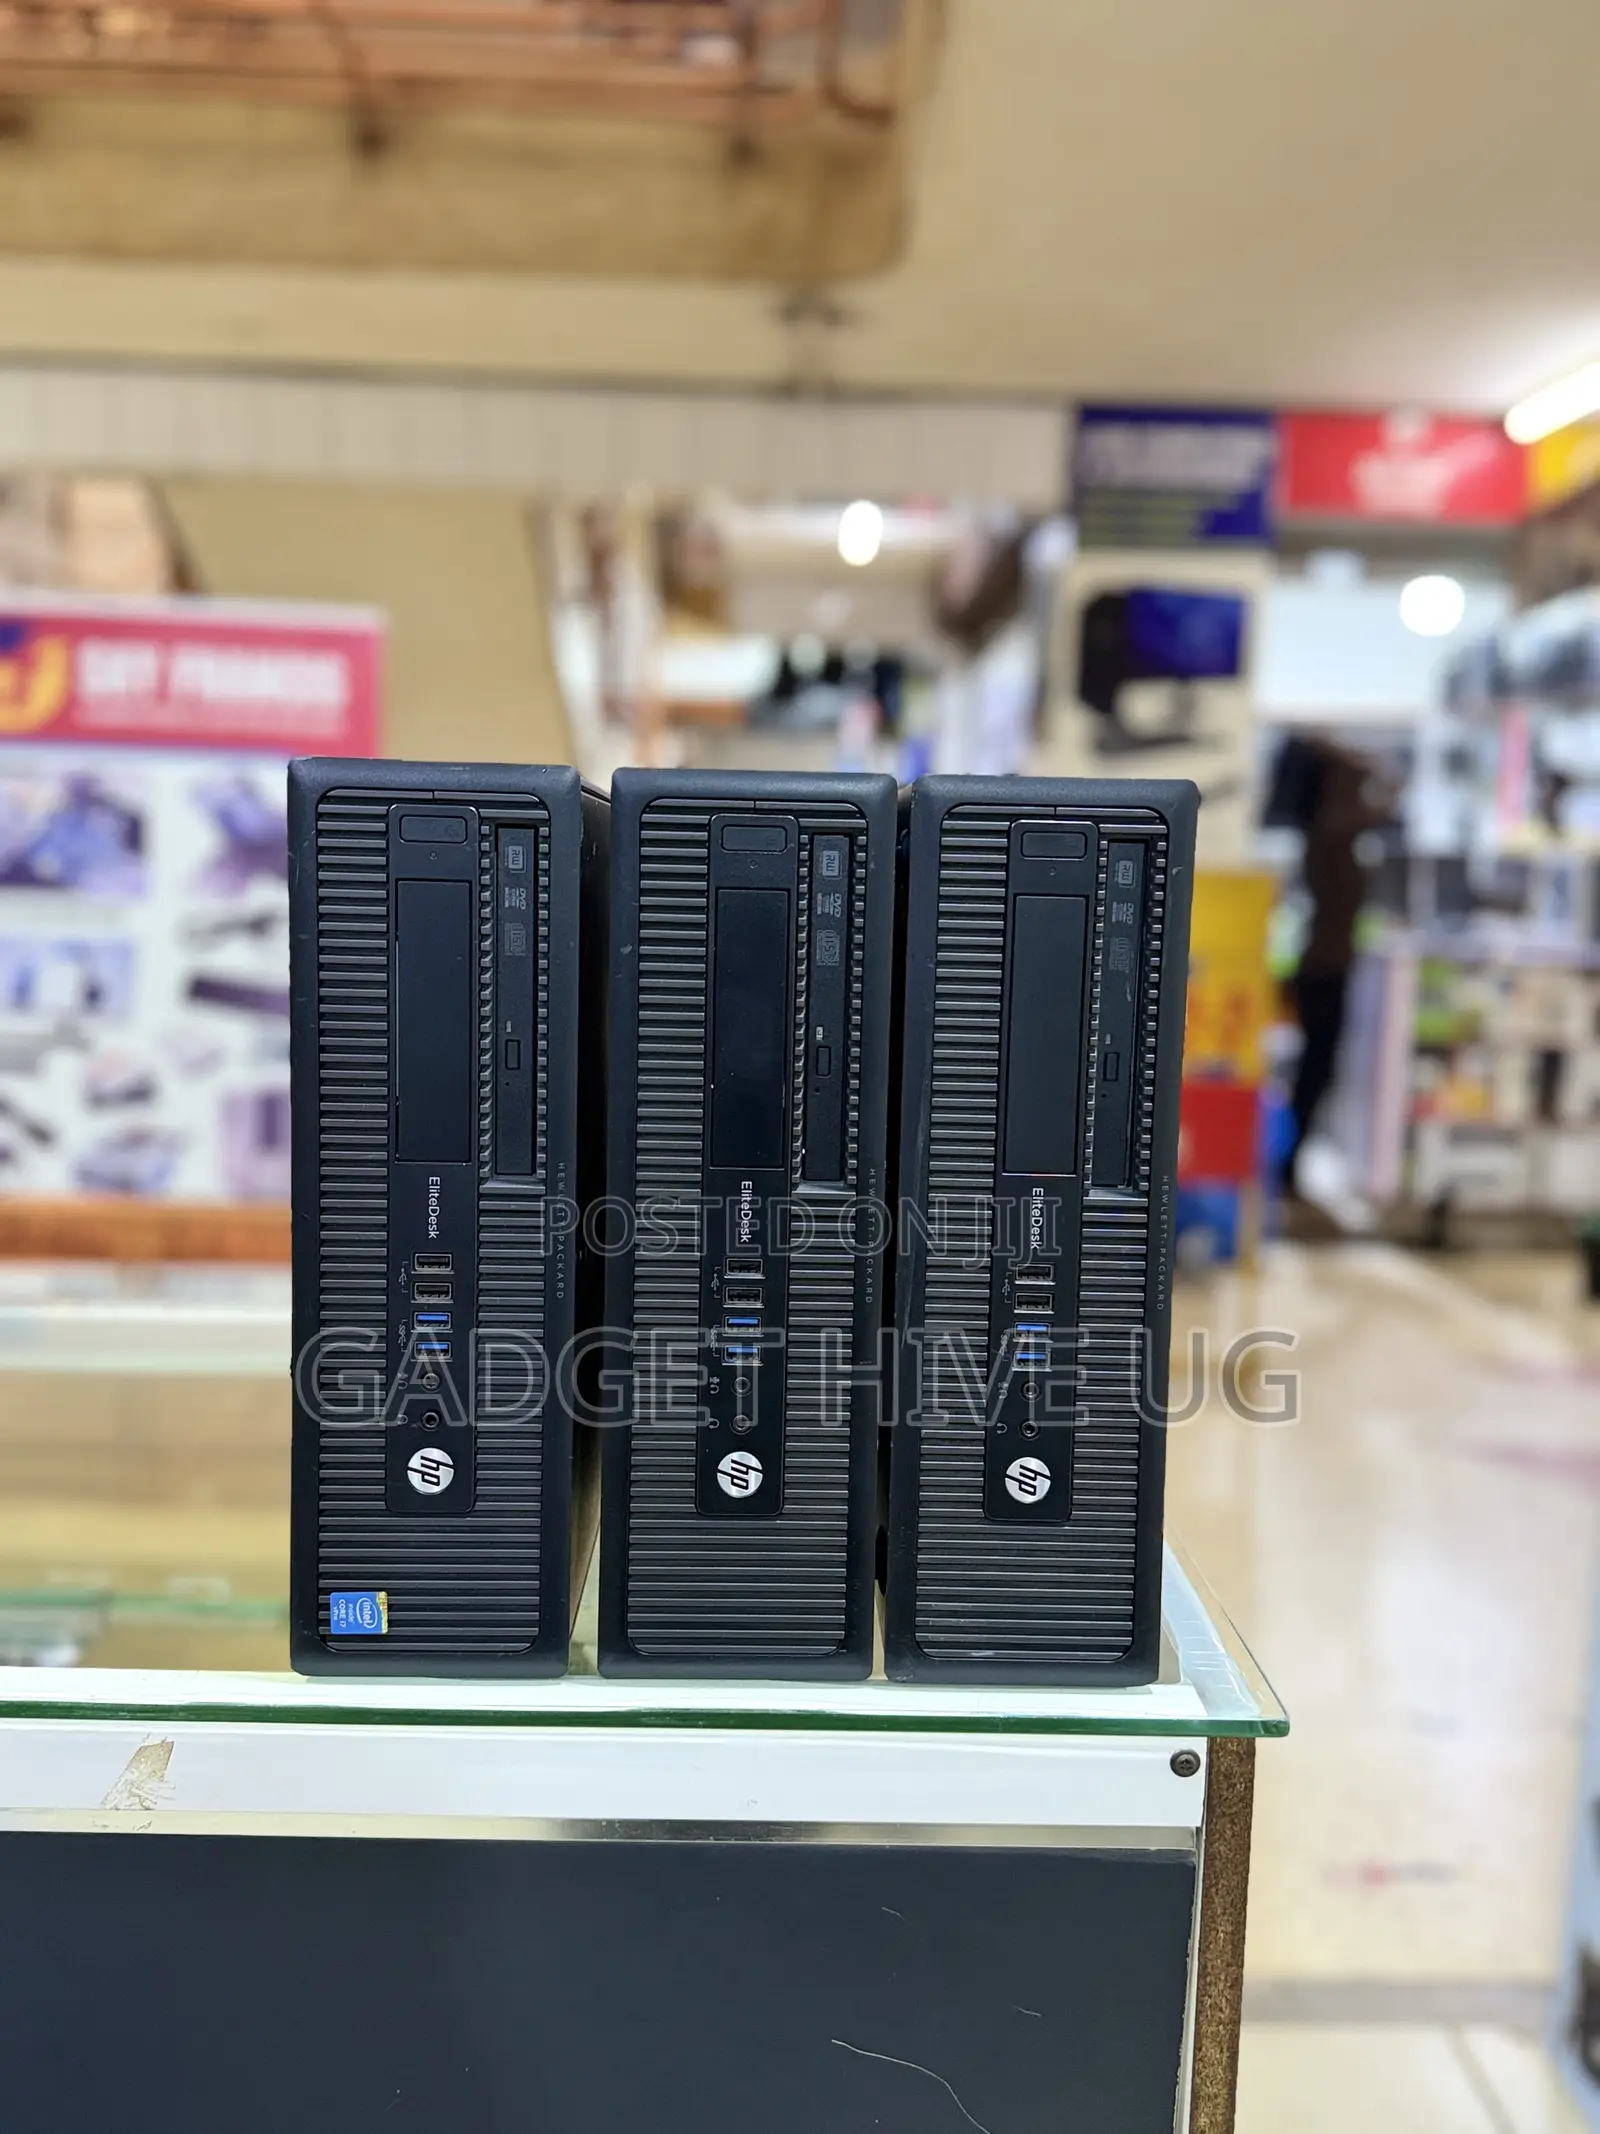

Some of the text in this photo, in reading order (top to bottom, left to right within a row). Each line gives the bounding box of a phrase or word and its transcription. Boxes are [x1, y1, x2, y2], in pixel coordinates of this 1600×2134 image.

[826, 854, 836, 872] RW
[519, 887, 527, 910] DVD
[833, 893, 842, 918] DVD
[1126, 902, 1134, 924] DVD
[428, 1176, 440, 1239] EliteDesk
[740, 1180, 753, 1243] EliteDesk
[1030, 1187, 1045, 1250] EliteDesk
[865, 1168, 877, 1303] HEWLETT-PACKARD
[1156, 1175, 1169, 1310] HEWLETT-PACKARD
[407, 1447, 454, 1494] hp
[716, 1451, 763, 1498] hp
[1005, 1457, 1051, 1504] hp
[339, 1599, 347, 1619] CORE
